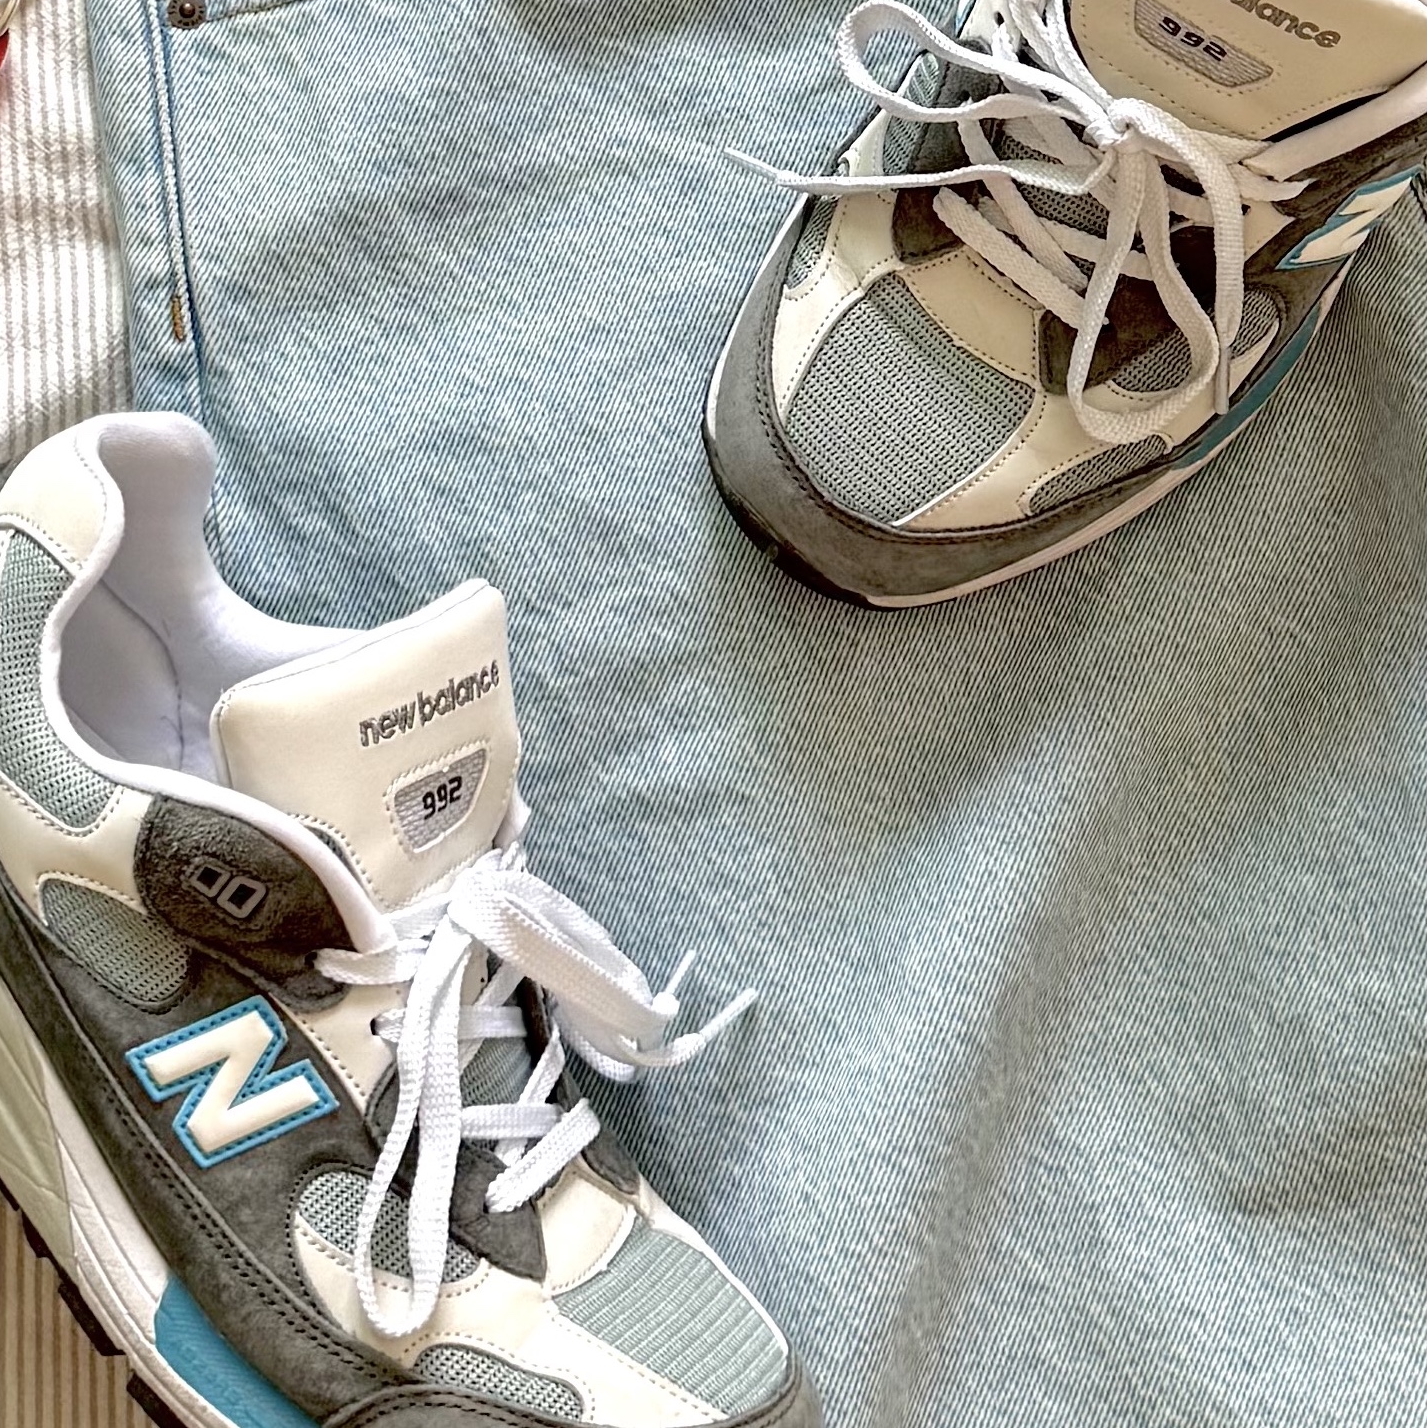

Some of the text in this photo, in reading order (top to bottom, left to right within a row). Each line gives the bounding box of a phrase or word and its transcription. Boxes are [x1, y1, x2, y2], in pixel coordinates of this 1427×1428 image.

[1158, 16, 1227, 62] 992
[422, 775, 463, 821] 992
[124, 995, 341, 1169] N
